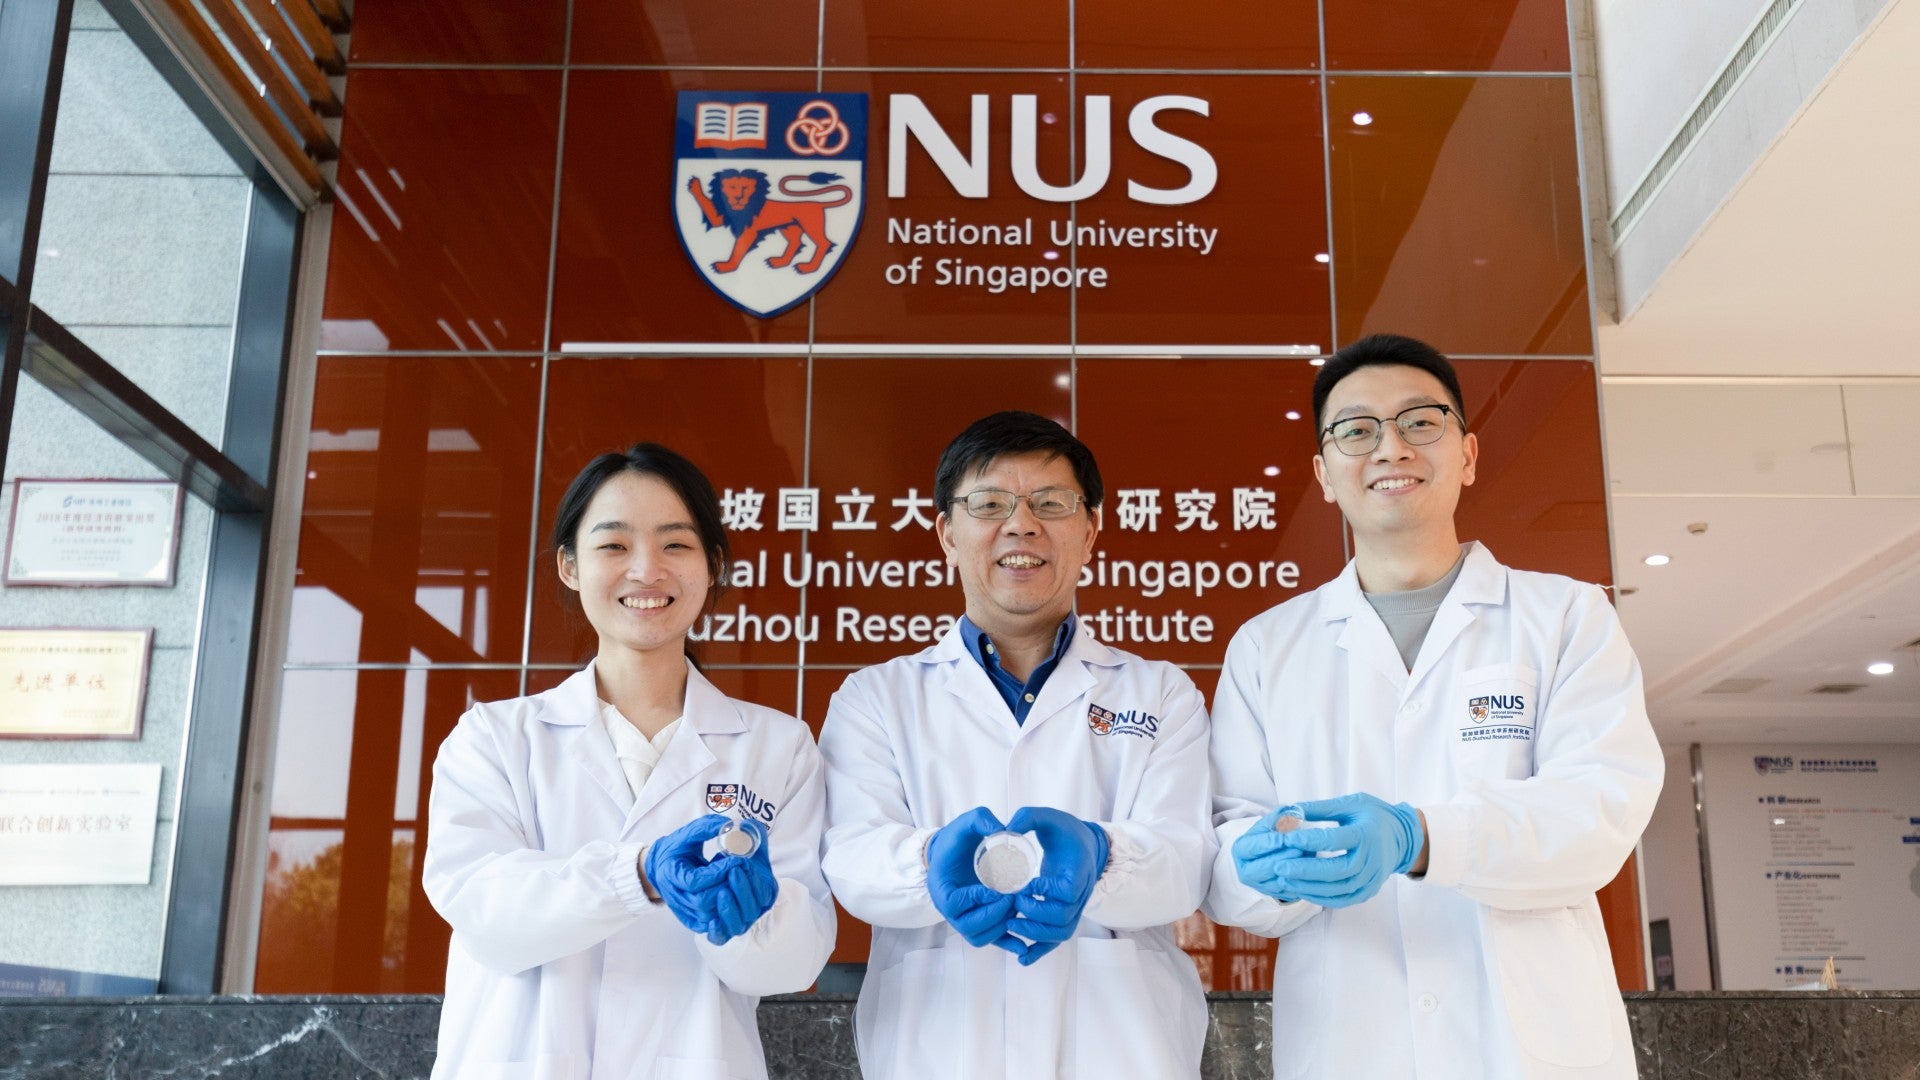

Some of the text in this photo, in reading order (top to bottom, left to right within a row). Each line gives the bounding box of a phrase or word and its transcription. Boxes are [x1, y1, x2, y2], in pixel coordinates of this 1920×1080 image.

[888, 94, 1218, 205] NUS
[888, 218, 1218, 254] National University
[885, 257, 1108, 293] of Singapore
[783, 551, 954, 588] Universi
[687, 604, 1214, 642] uzhou Resea stitute
[1491, 695, 1524, 709] NUS
[1116, 710, 1158, 732] NUS
[1768, 757, 1793, 767] NUS
[740, 784, 775, 822] NUS
